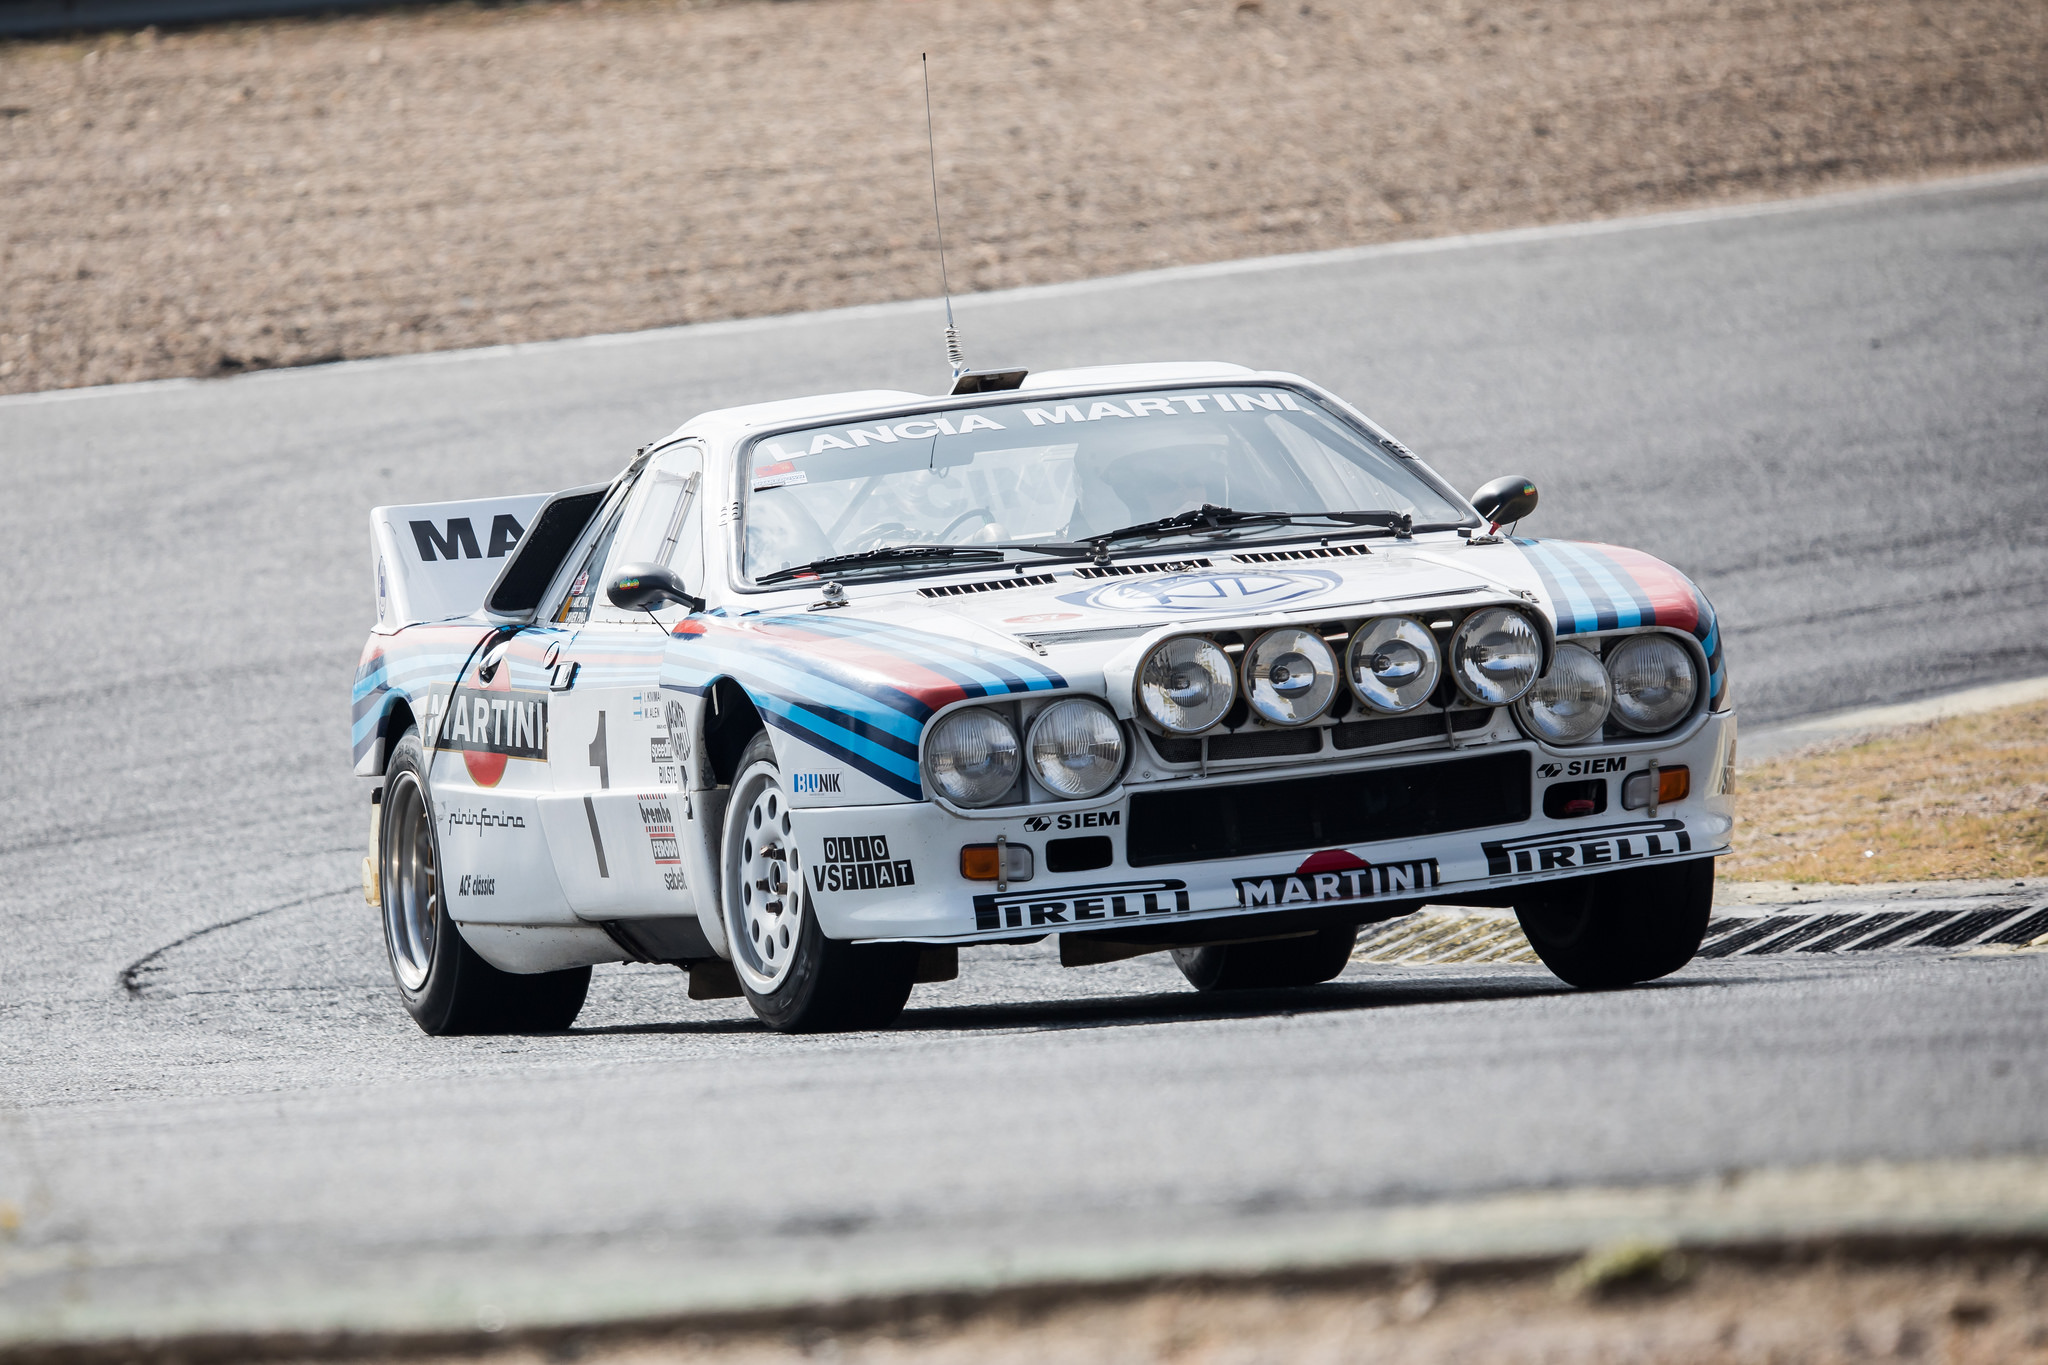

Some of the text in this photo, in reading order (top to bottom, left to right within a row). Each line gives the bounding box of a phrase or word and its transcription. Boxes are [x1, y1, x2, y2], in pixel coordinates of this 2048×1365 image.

[765, 393, 1302, 462] LANCIA MARTINI
[427, 693, 544, 750] MARTINI
[793, 773, 842, 793] BLUNIK
[1567, 756, 1627, 776] SIEM
[638, 801, 672, 823] brembo
[1057, 810, 1121, 830] SIEM
[823, 835, 890, 863] OLIO
[1480, 818, 1692, 876] PIRELLI
[1240, 862, 1432, 908] MARTINI
[972, 879, 1190, 931] PIRELLI
